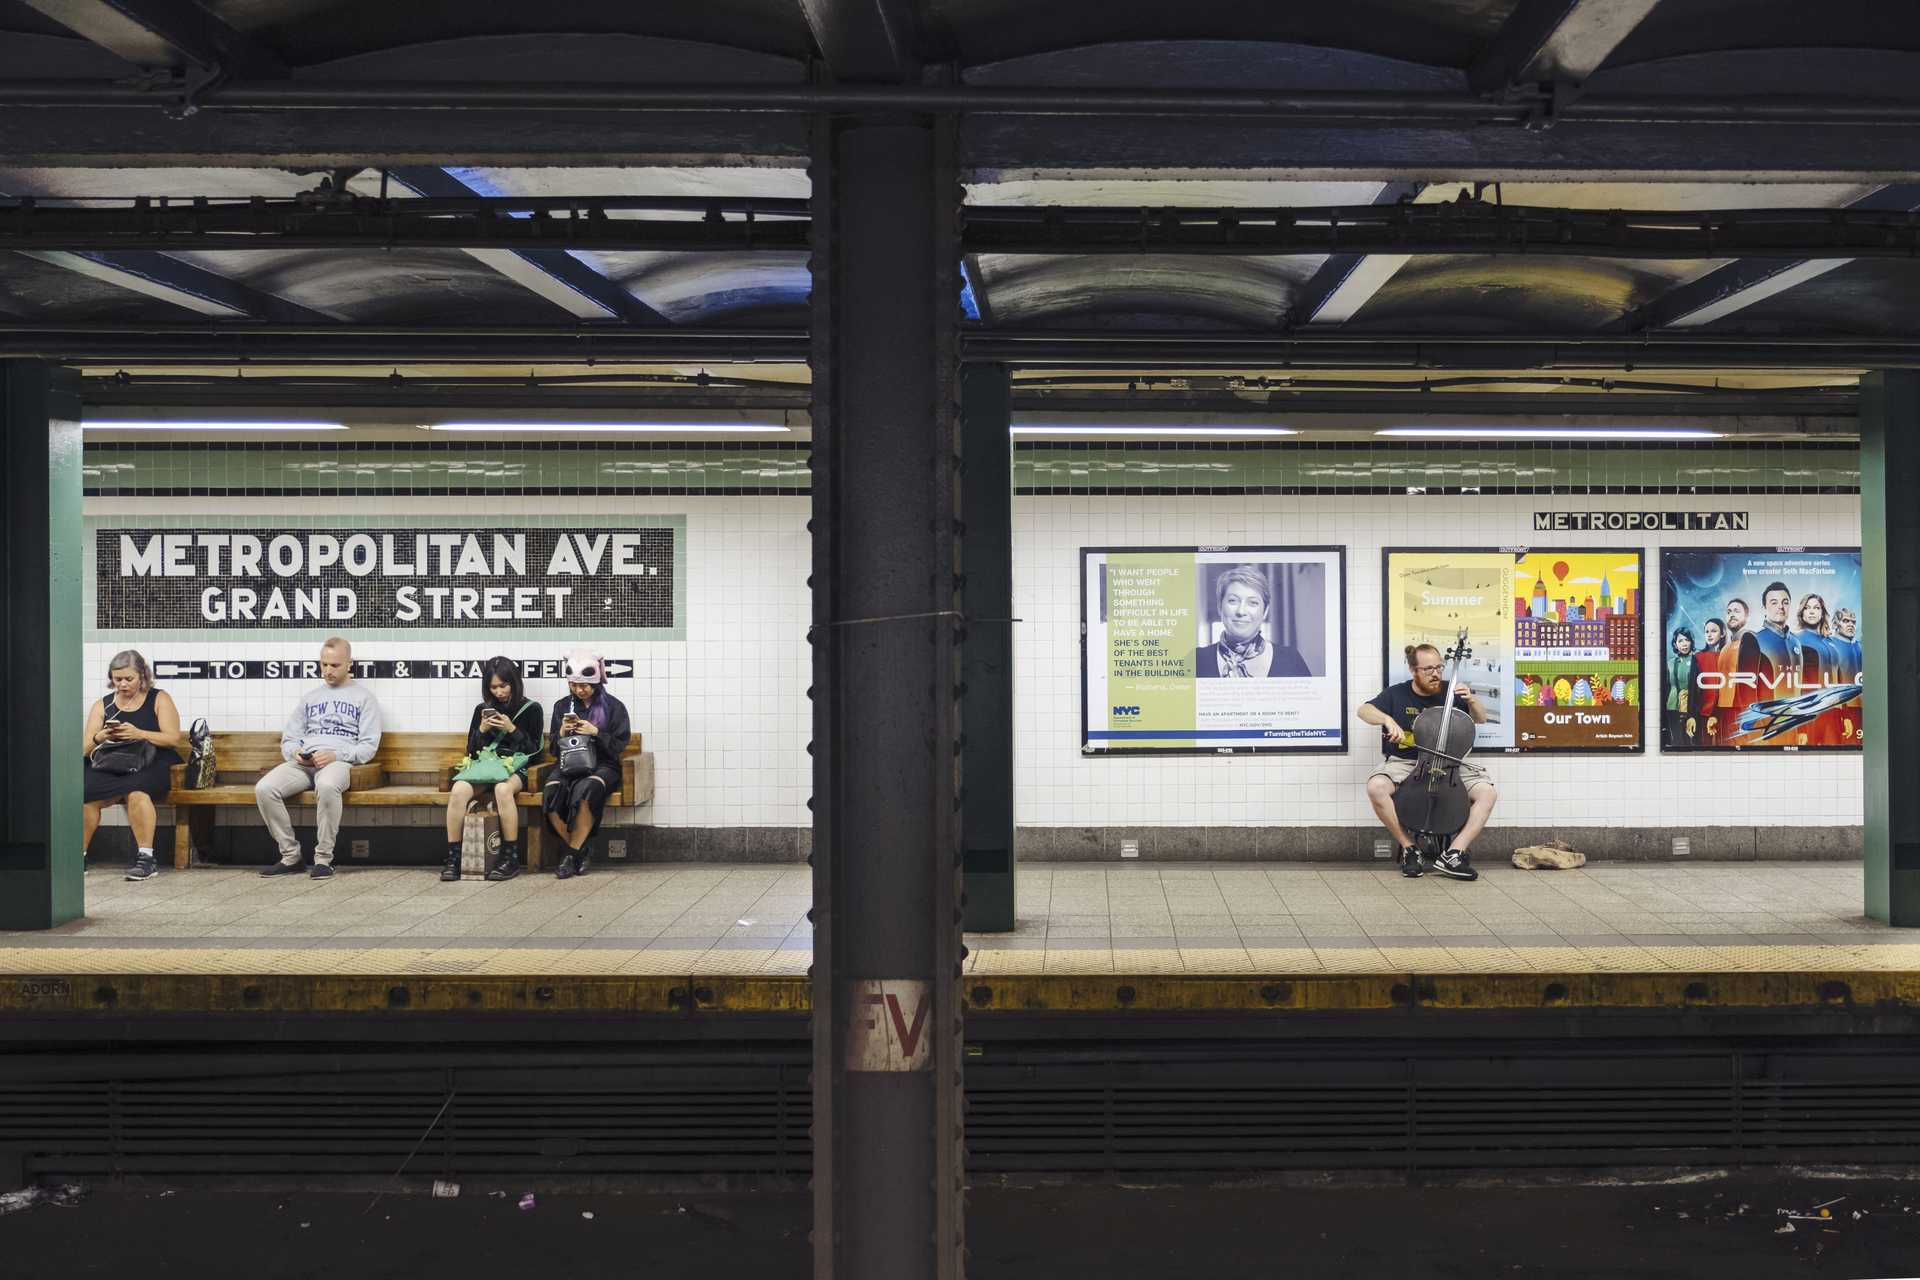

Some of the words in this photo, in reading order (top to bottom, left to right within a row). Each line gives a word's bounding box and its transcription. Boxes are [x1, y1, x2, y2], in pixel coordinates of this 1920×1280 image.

[1535, 513, 1747, 529] METROPOLITAN
[120, 533, 526, 577] METROPOLITAN
[546, 533, 658, 577] AVE.
[1118, 568, 1144, 576] WANT
[1146, 568, 1180, 576] PEOPLE
[1113, 578, 1134, 586] WHO
[1136, 578, 1160, 586] WENT
[1421, 591, 1484, 605] Summer
[201, 586, 357, 621] GRAND
[395, 586, 572, 621] STREET
[1113, 599, 1164, 607] SOMETHING
[1113, 609, 1157, 617] DIFFICULT
[1159, 609, 1168, 617] IN
[1170, 608, 1189, 616] LIFE
[1113, 619, 1125, 627] TO
[1141, 619, 1164, 627] ABLE
[1113, 629, 1137, 637] HAVE
[1139, 629, 1145, 637] A
[1113, 639, 1140, 647] SHE'S
[1141, 639, 1160, 647] ONE
[1113, 649, 1125, 657] OF
[1128, 649, 1145, 657] THE
[1146, 649, 1168, 657] BEST
[1113, 659, 1154, 667] TENANTS
[1161, 659, 1185, 667] HAVE
[209, 661, 245, 679] TO
[266, 661, 374, 679] STRT
[395, 661, 410, 678] &
[431, 661, 568, 678] TRAFE
[1113, 669, 1123, 677] IN
[1125, 669, 1143, 677] THE
[1696, 671, 1863, 690] ORVILL
[1113, 706, 1141, 716] NYC
[1544, 712, 1572, 724] Our
[1575, 712, 1610, 724] Town
[1264, 730, 1327, 738] #TurningtheTideNYC
